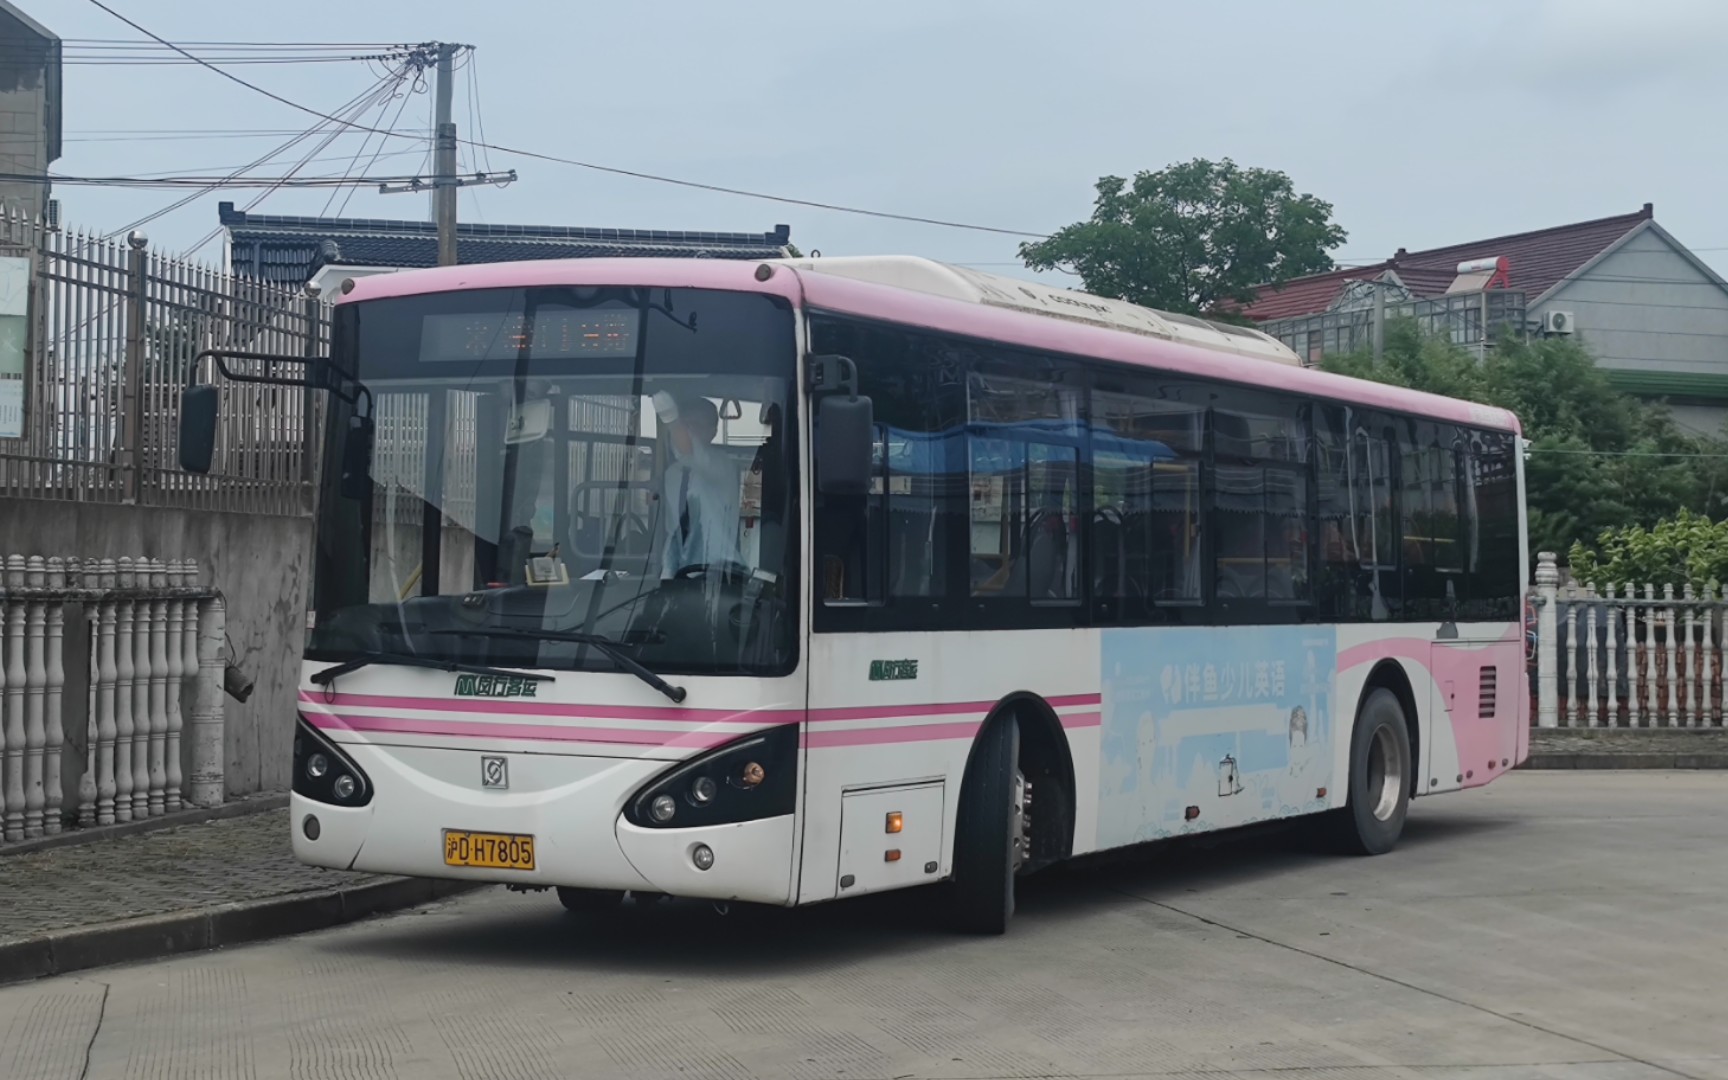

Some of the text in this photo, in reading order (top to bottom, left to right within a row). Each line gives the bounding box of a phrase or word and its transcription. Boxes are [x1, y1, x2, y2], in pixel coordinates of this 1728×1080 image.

[1184, 659, 1285, 703] 伴鱼少儿英语
